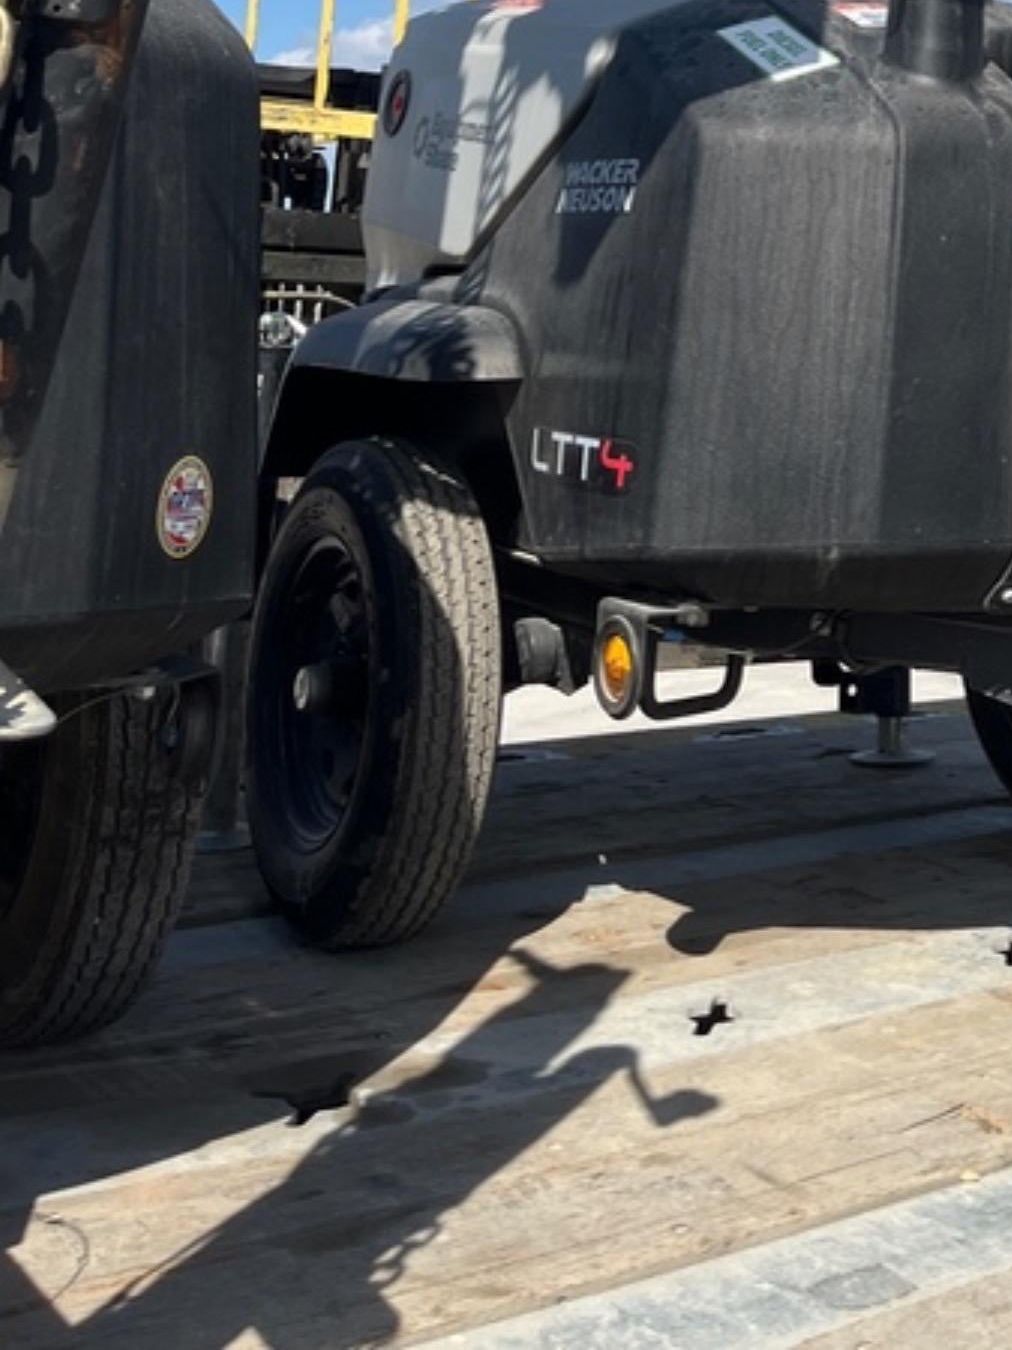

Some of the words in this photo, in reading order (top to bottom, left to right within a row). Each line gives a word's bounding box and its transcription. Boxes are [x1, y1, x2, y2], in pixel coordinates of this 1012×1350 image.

[566, 158, 640, 184] WACKER
[555, 185, 636, 214] NEUSON
[531, 428, 634, 488] LTT4
